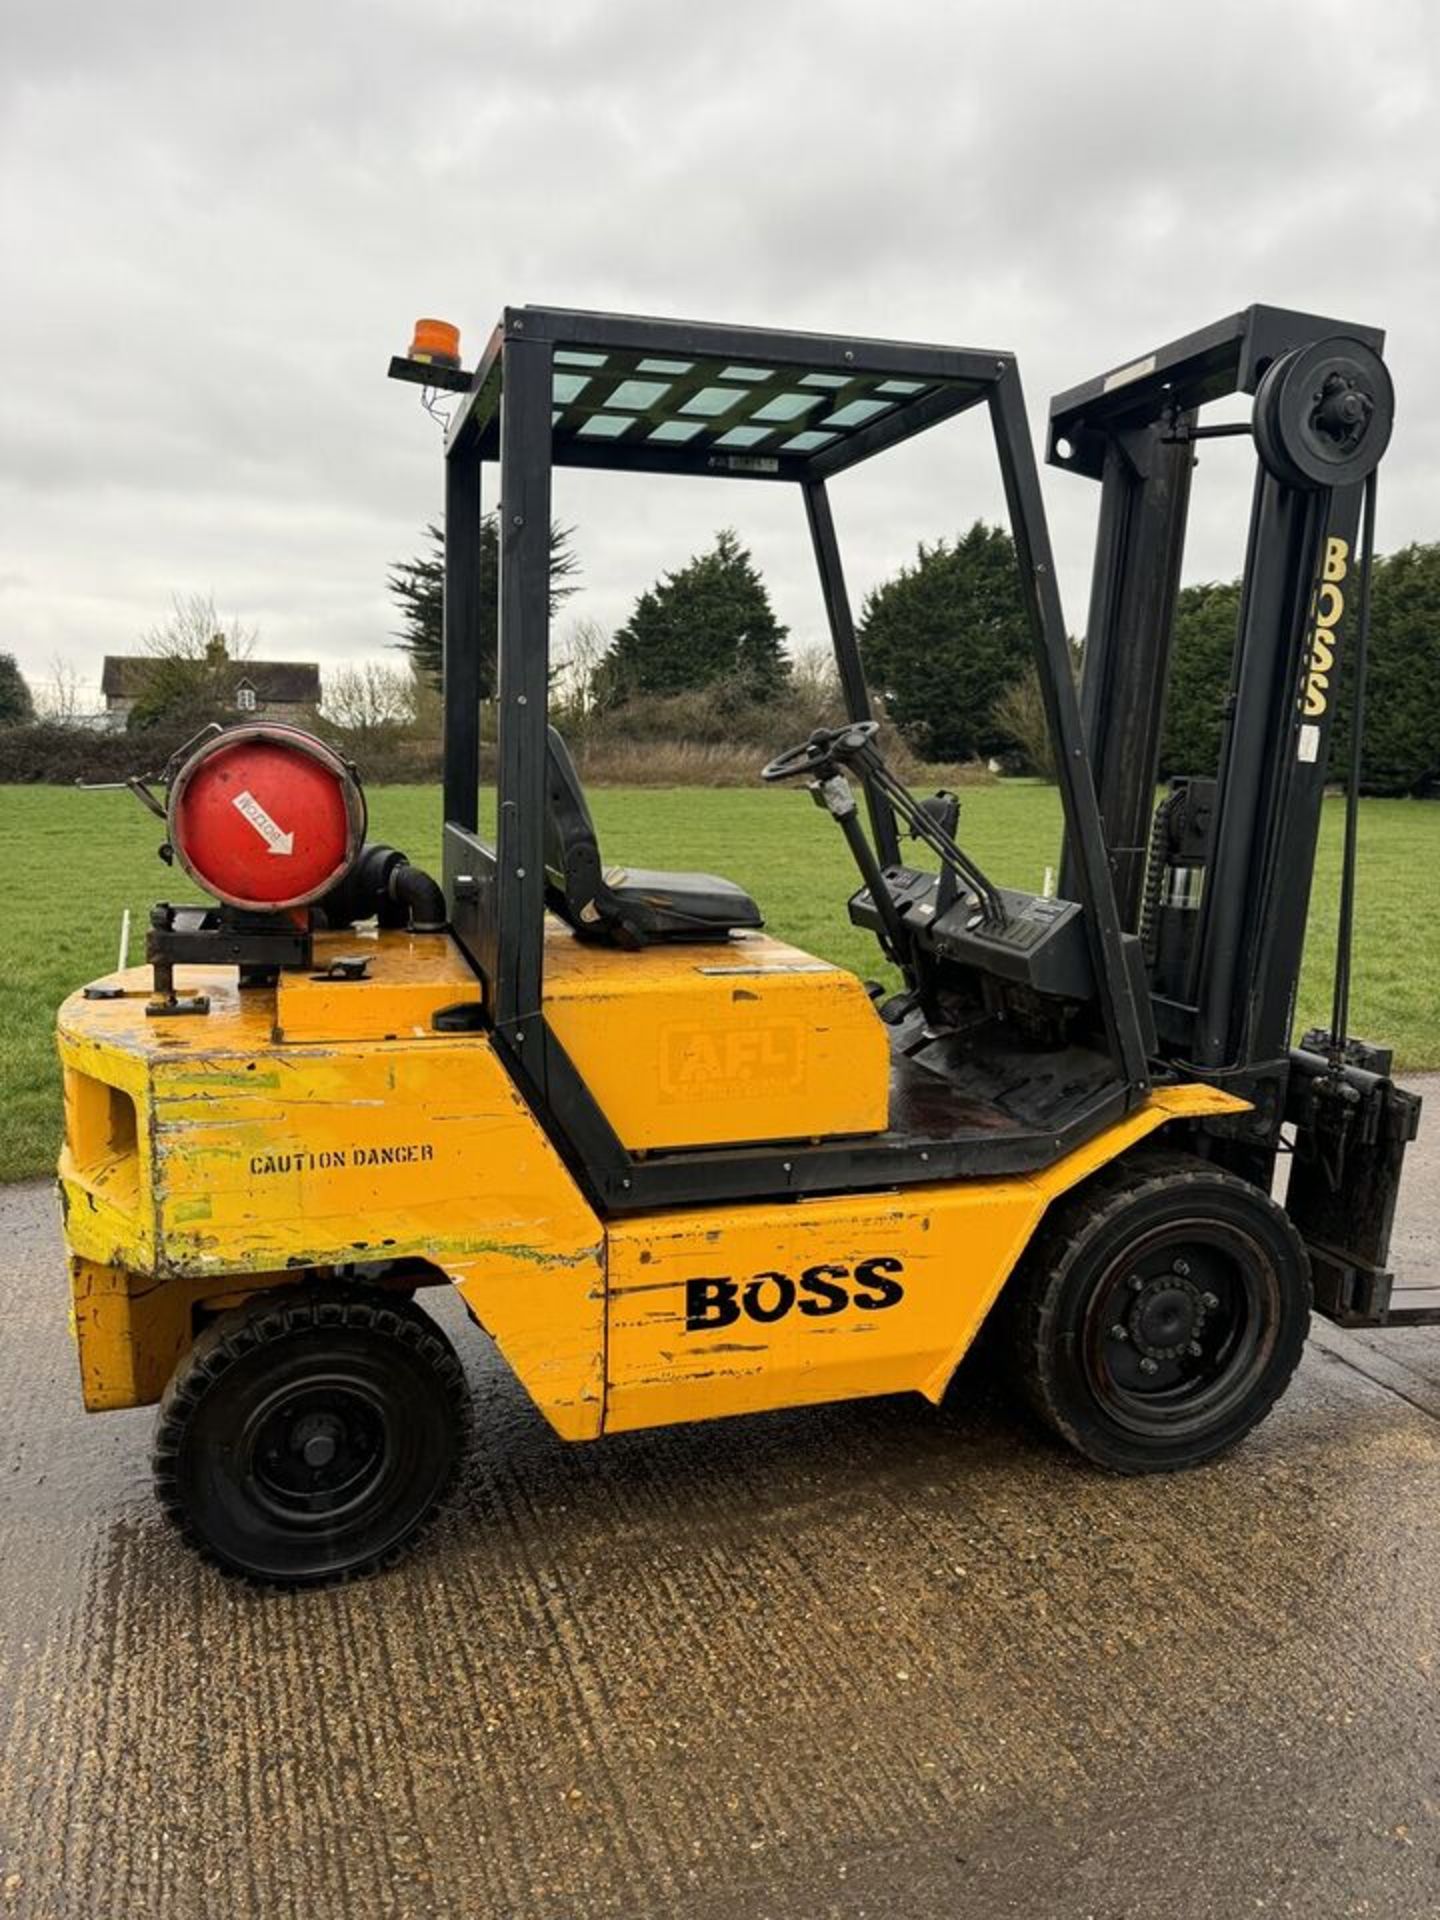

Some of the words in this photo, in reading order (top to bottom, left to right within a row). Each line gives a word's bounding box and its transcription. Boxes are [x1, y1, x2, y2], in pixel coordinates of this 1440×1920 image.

[1301, 536, 1349, 716] BOSS
[250, 1152, 345, 1175] CAUTION
[353, 1144, 433, 1167] DANGER
[685, 1257, 904, 1332] BOSS
